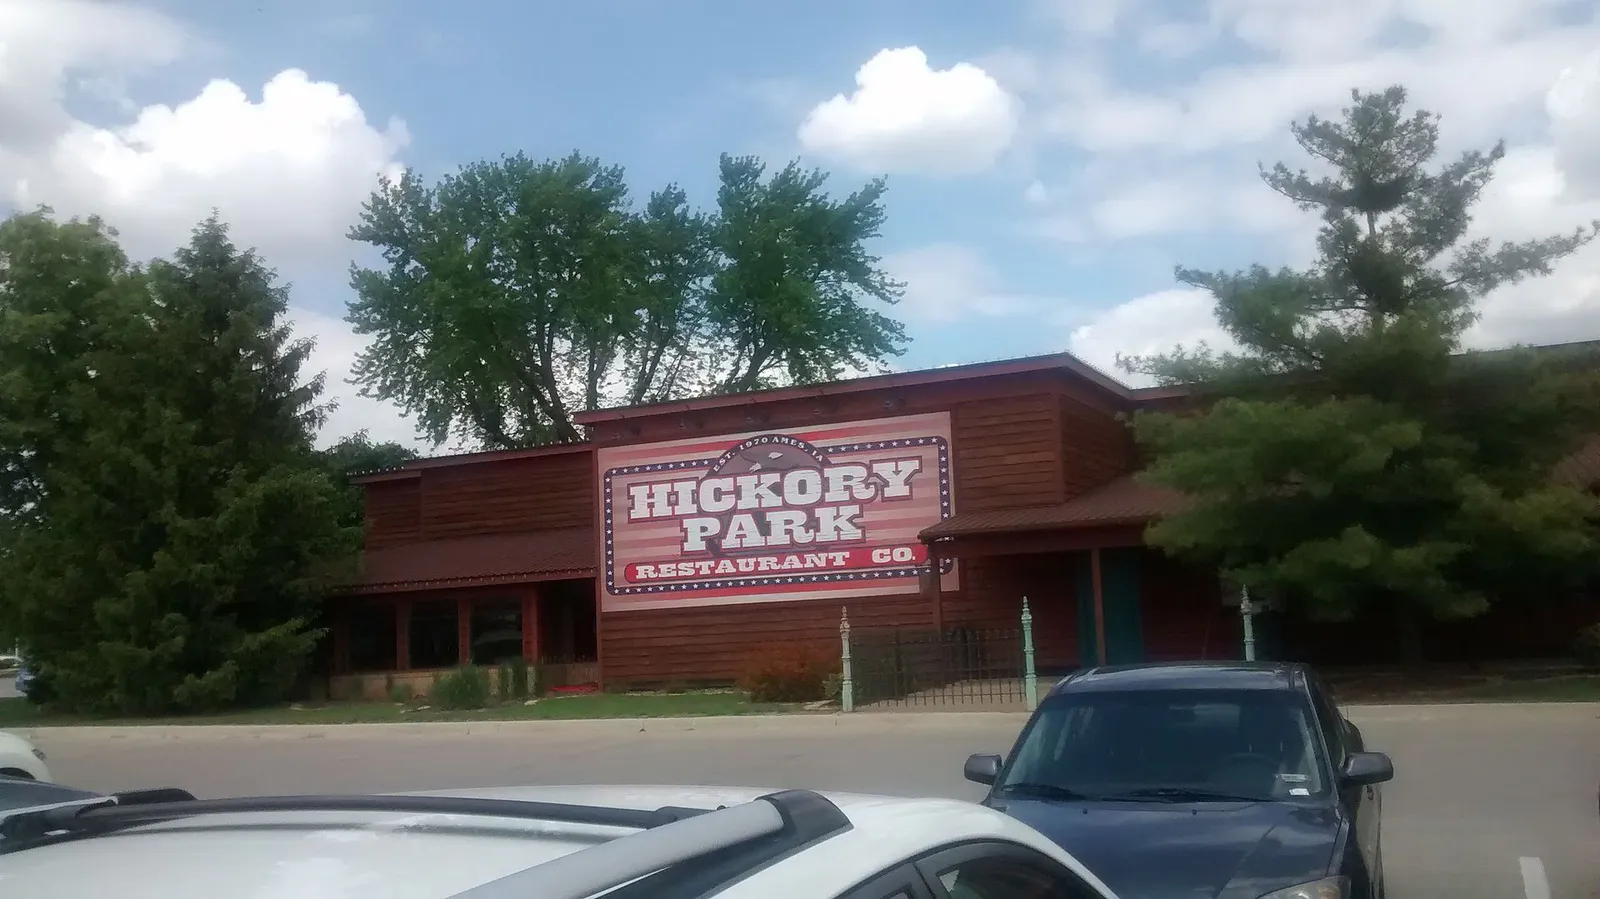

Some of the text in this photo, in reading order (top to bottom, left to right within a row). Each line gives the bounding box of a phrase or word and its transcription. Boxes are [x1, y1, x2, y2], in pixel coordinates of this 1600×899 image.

[712, 436, 824, 473] EST. 1970 AMES, IA
[629, 459, 920, 520] HICKORY
[682, 504, 863, 552] PARK
[635, 546, 916, 580] RESTAURANT CO.
